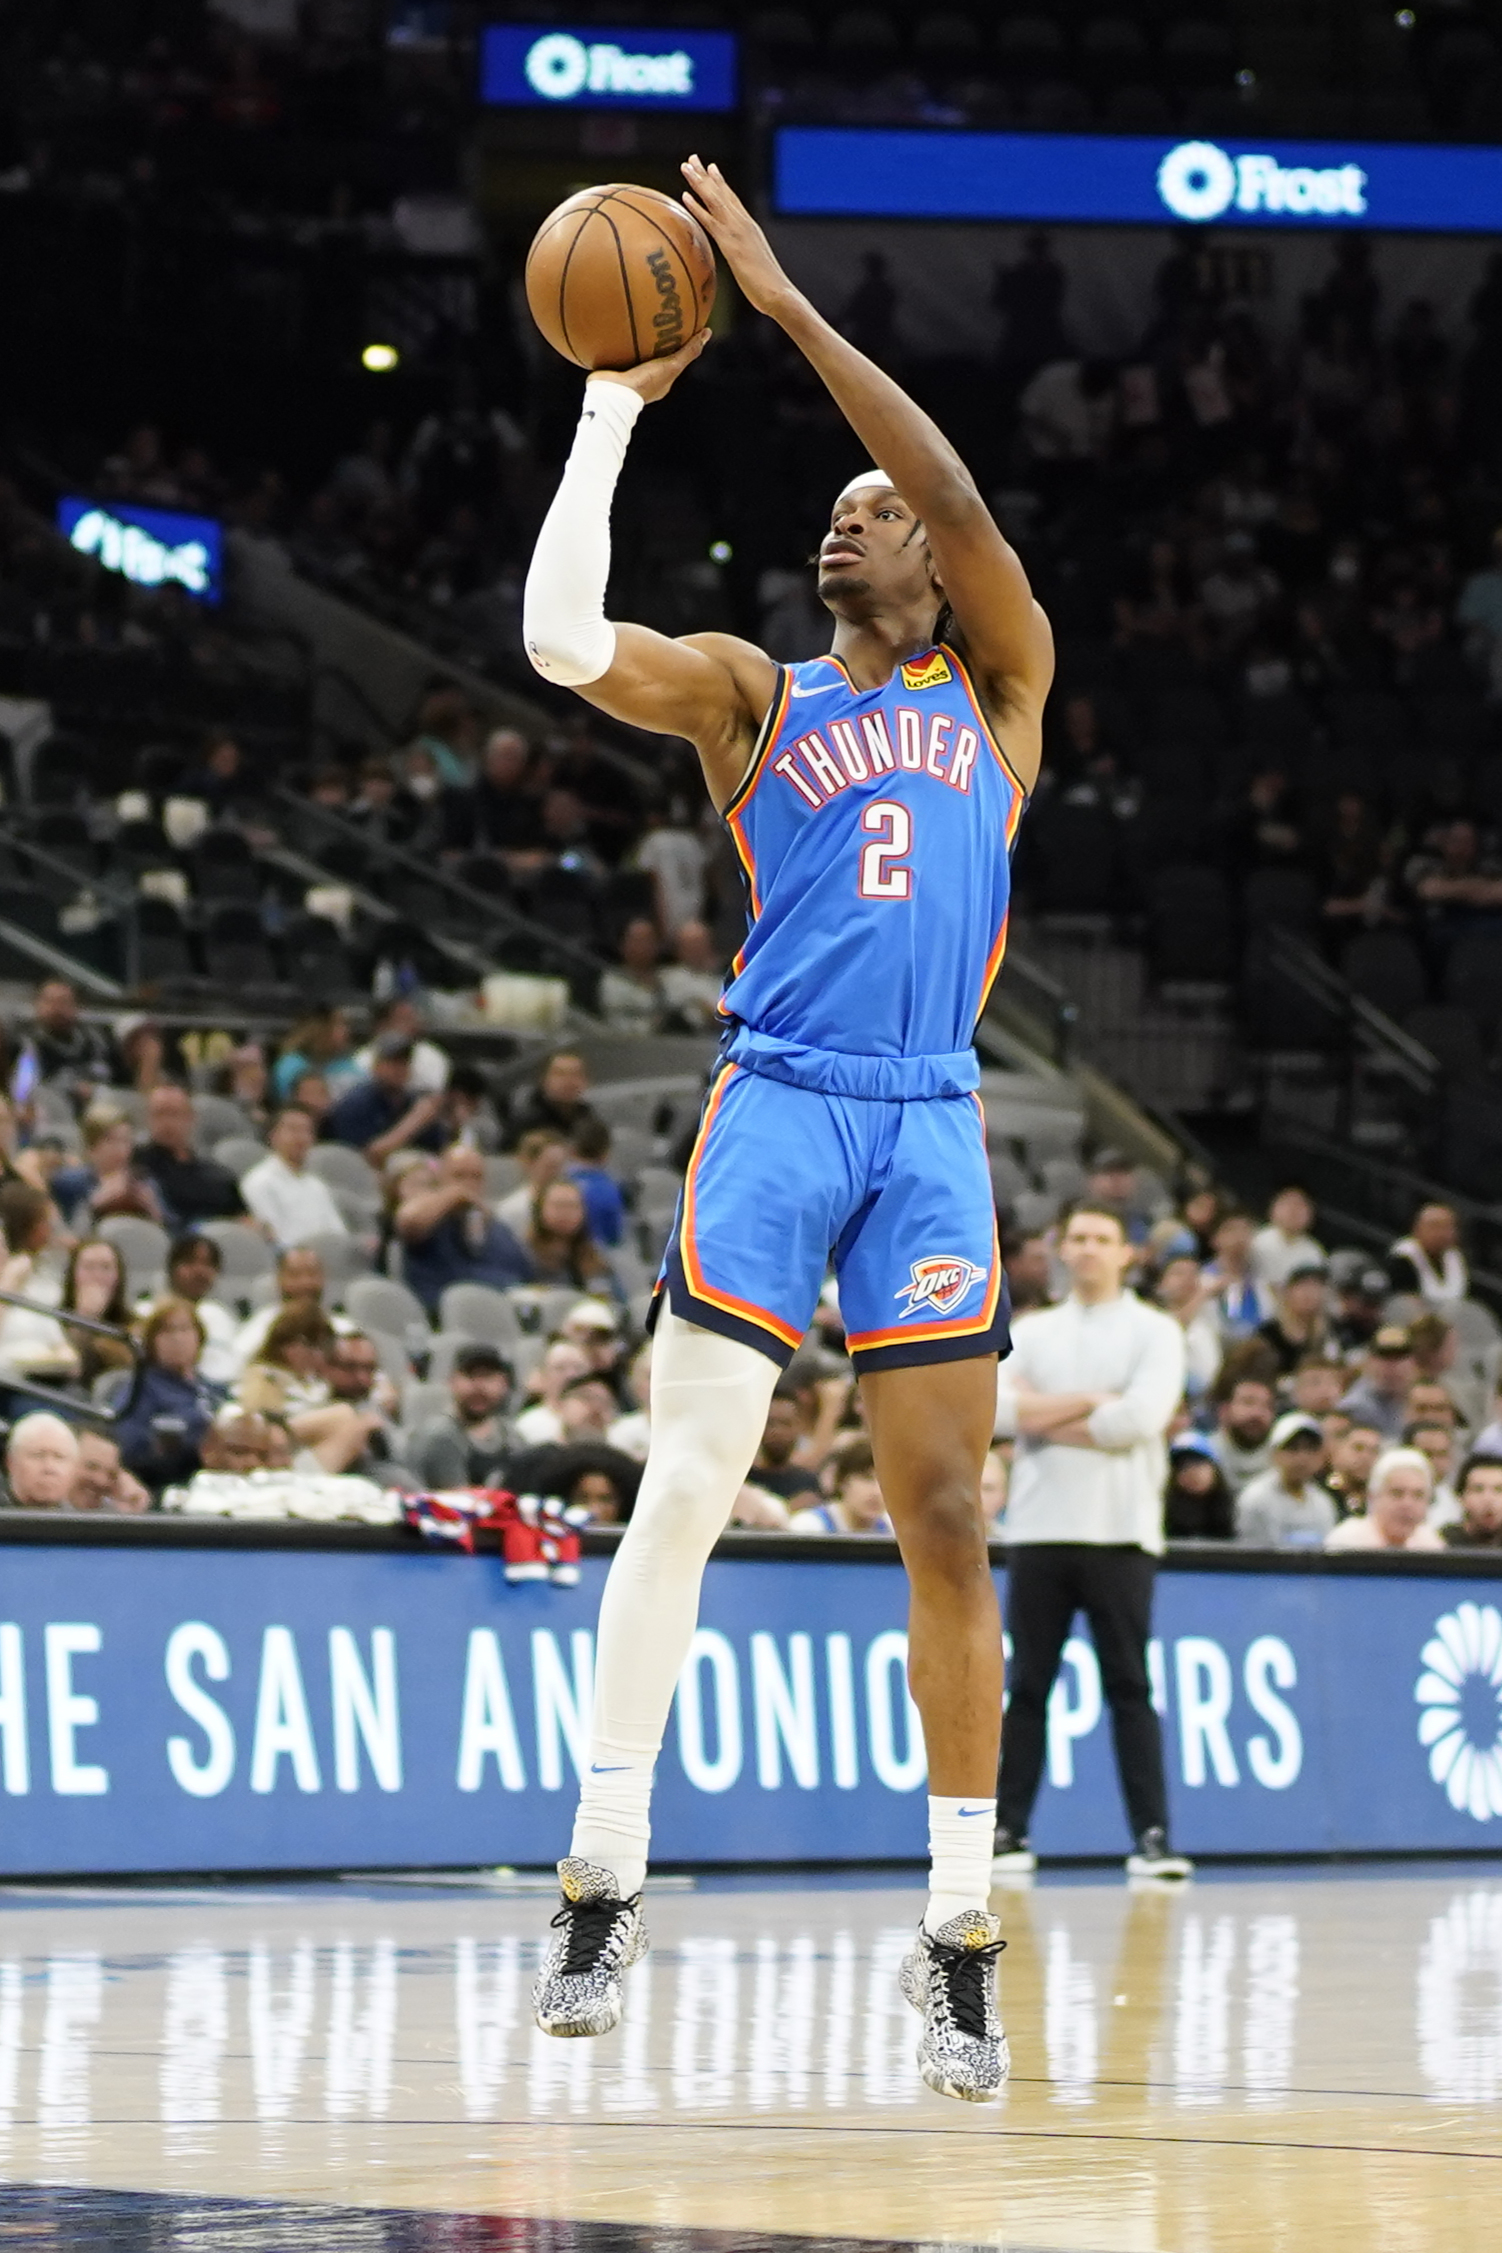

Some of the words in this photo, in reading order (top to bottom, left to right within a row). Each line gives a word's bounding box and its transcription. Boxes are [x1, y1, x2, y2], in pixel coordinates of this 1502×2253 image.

[587, 43, 693, 93] Frost
[1236, 153, 1368, 215] Frost
[772, 706, 979, 812] THUNDER
[857, 798, 912, 900] 2
[911, 1267, 961, 1303] OKC
[164, 1620, 404, 1798] SAN
[456, 1626, 928, 1793] ANONIO
[1001, 1631, 1304, 1791] PRS
